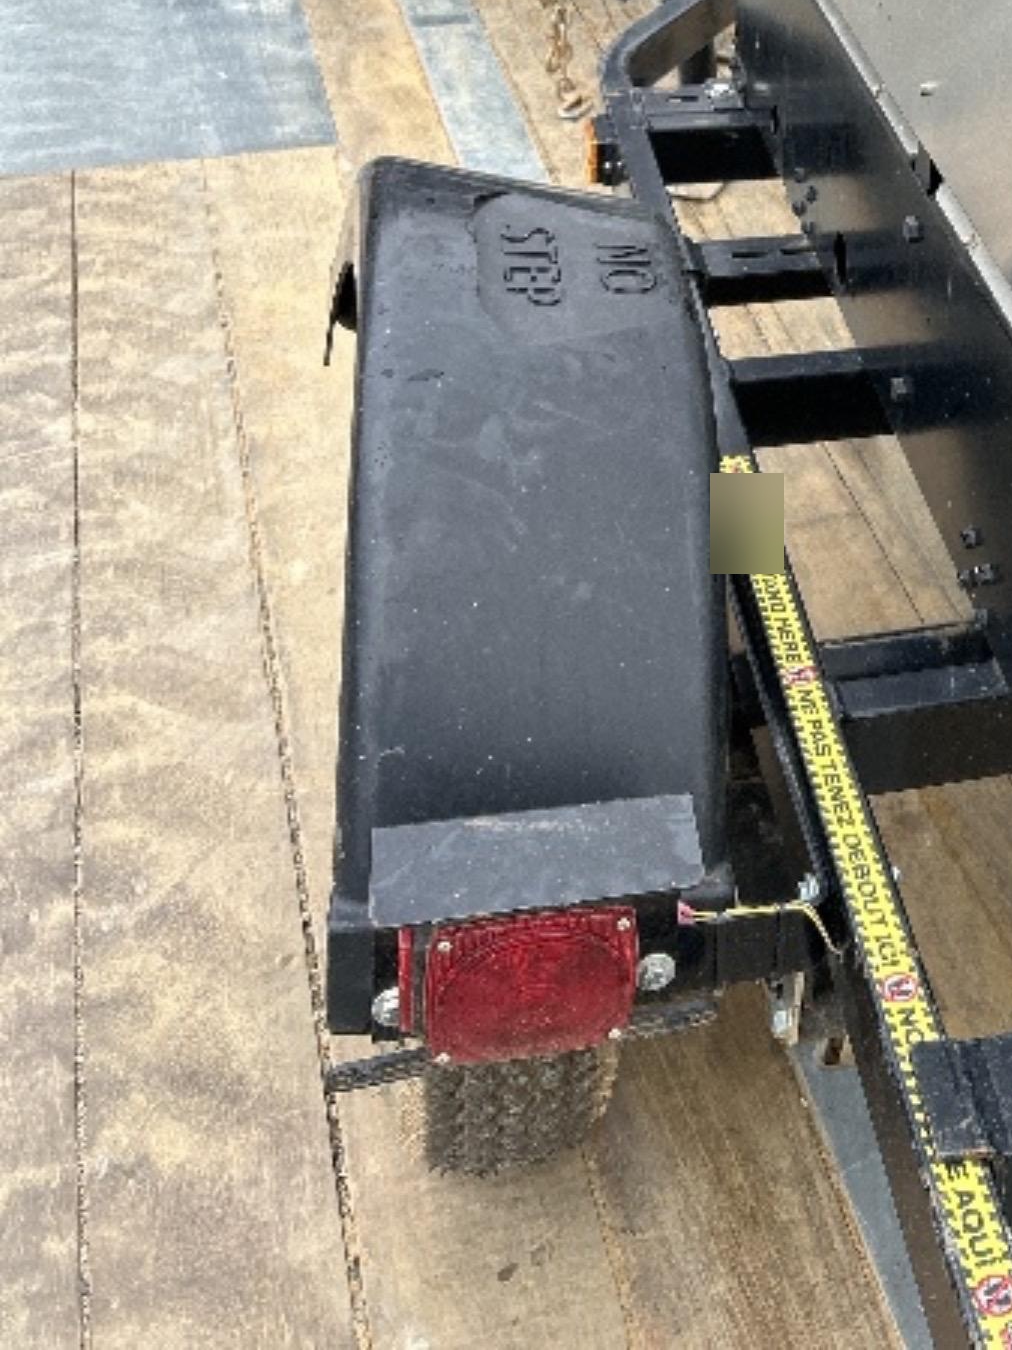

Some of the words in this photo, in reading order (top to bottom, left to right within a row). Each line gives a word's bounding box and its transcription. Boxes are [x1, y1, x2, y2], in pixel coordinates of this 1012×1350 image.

[500, 224, 563, 307] STEP
[596, 244, 658, 295] NO
[773, 616, 803, 664] HERE
[806, 718, 832, 757] PAS
[842, 833, 888, 928] DEBOUT
